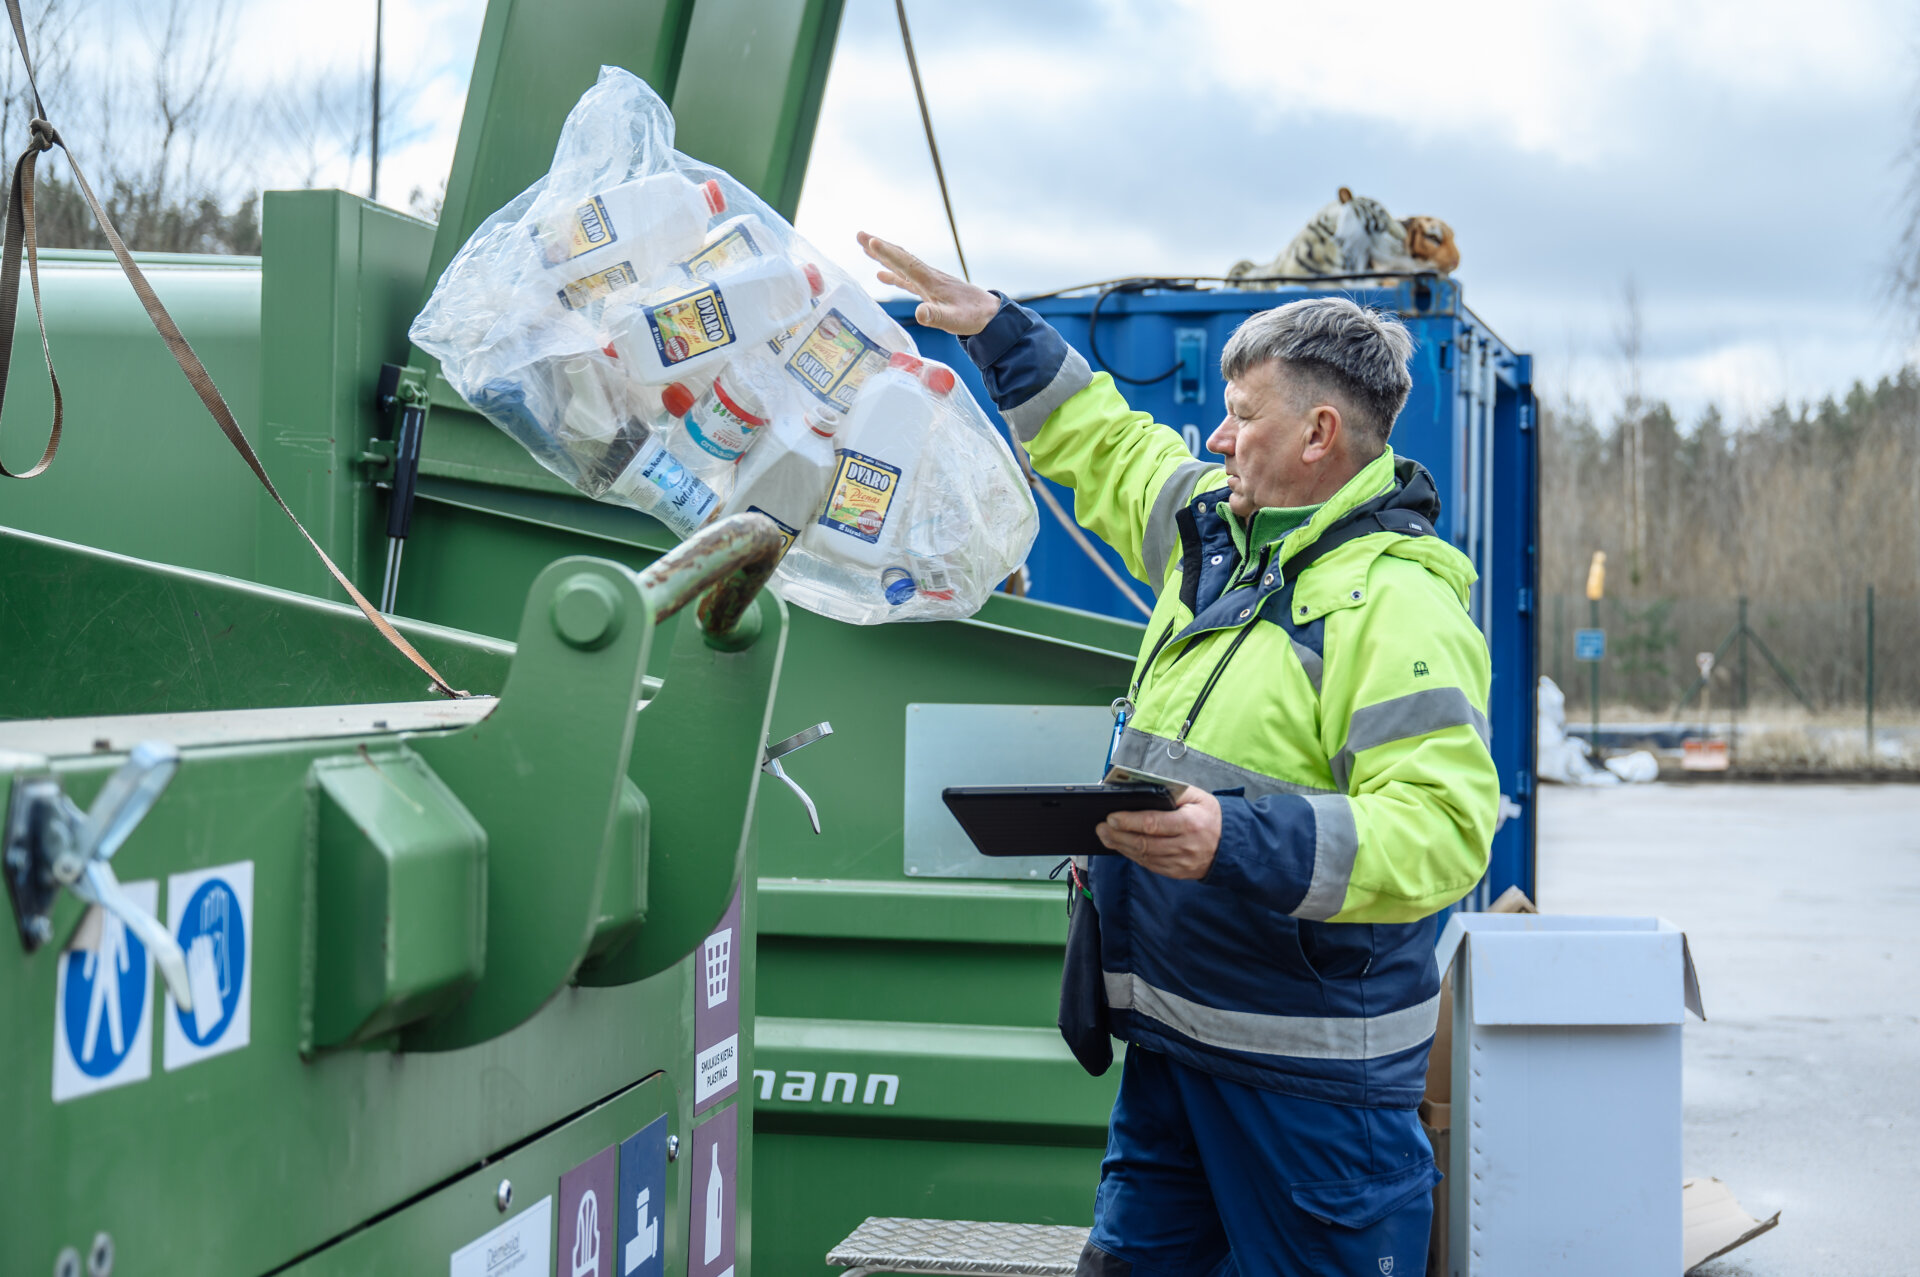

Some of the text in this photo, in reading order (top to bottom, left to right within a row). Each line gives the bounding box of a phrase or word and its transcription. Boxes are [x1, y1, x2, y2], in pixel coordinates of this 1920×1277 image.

[577, 203, 606, 243] DVARO
[695, 295, 724, 342] DVARO
[796, 351, 834, 388] DVARO
[846, 462, 891, 492] DVARO
[849, 487, 880, 504] Pienas
[701, 1046, 733, 1073] SMULKUS KIETAS
[707, 1066, 727, 1088] PLASTIKAS
